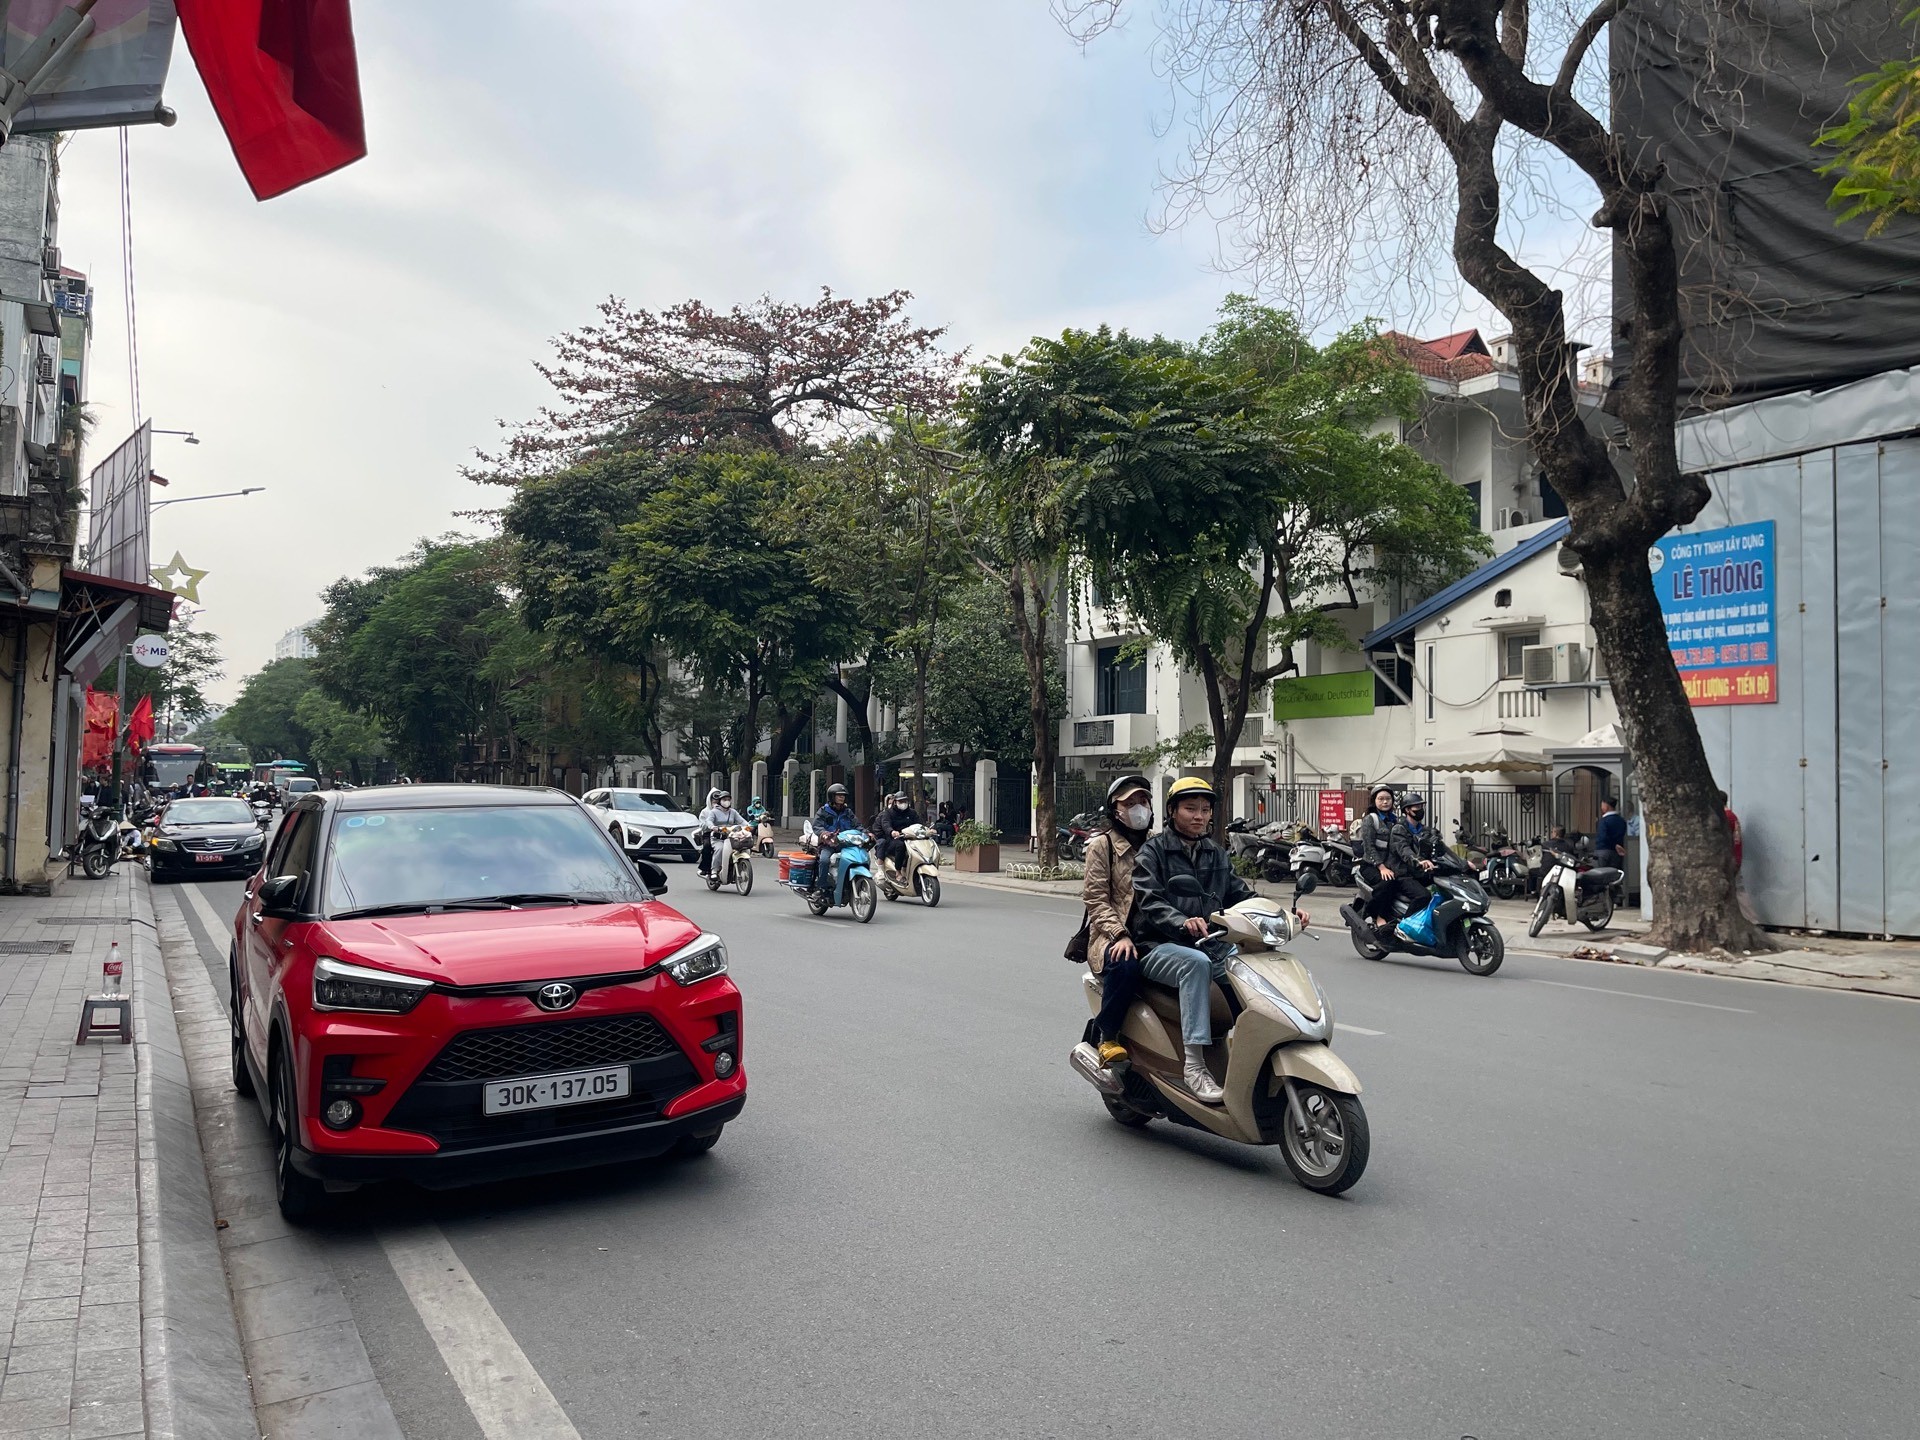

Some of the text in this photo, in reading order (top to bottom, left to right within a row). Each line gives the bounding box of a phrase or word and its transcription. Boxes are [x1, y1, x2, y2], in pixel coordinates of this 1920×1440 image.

[1671, 533, 1764, 560] CÔNG TY TNHH XÂY DỰNG
[1673, 558, 1764, 600] LÊ THÔNG
[150, 647, 167, 656] MB
[1703, 677, 1729, 701] LƯỢNG
[1736, 670, 1755, 695] TIẾN
[498, 1073, 618, 1107] 30K-137.05
